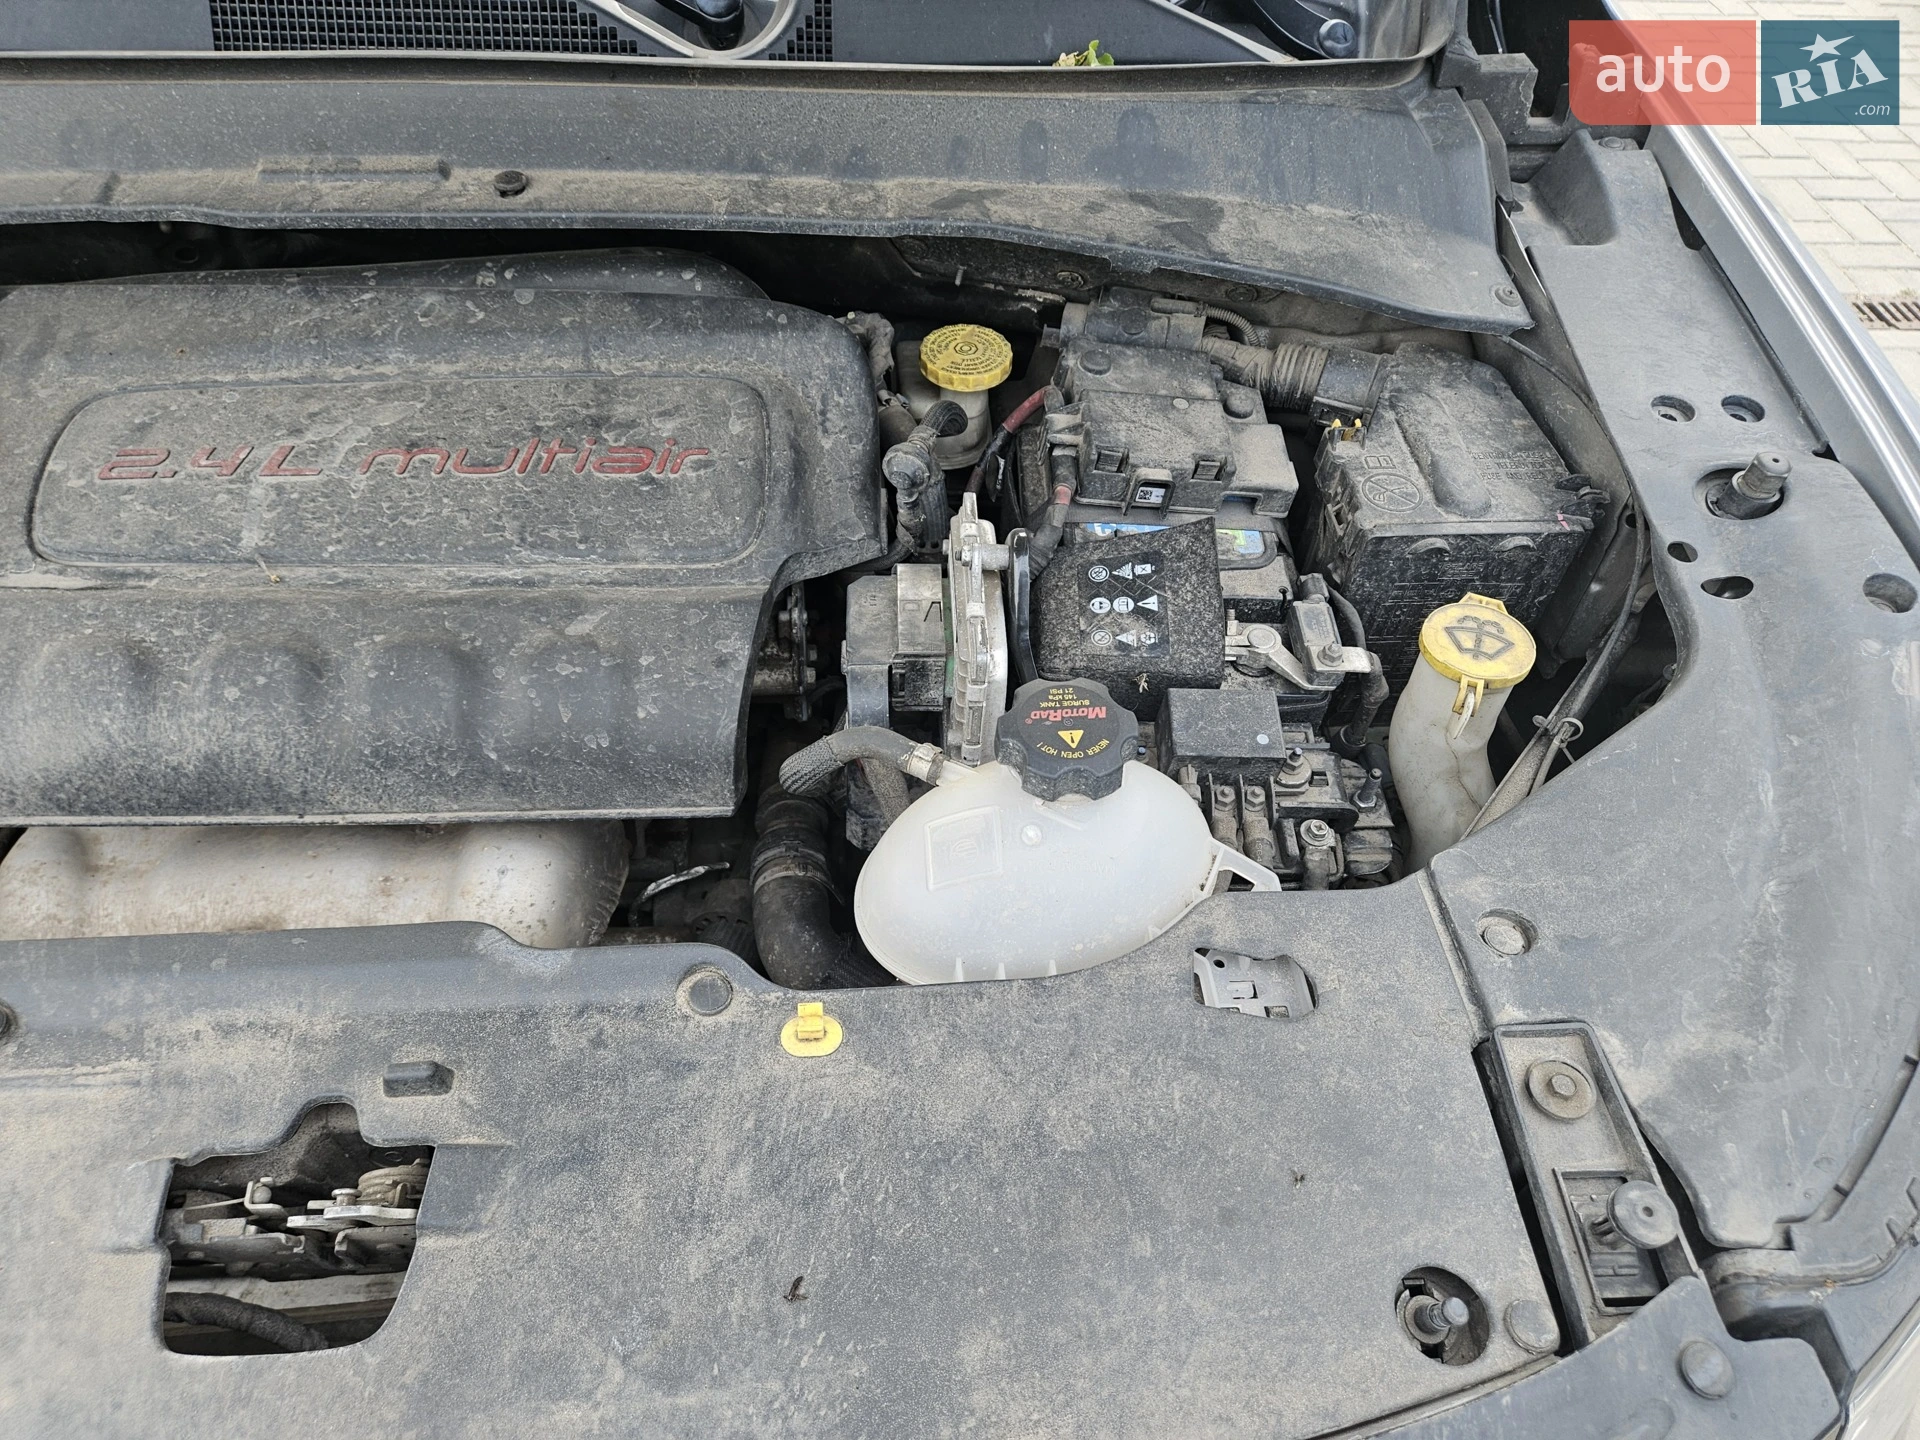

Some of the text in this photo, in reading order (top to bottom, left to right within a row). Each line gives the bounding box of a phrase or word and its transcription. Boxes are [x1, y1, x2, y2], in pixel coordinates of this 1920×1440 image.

[99, 437, 710, 480] 2.4L multiair
[1061, 751, 1084, 759] OPEN
[1086, 738, 1110, 756] NEVER
